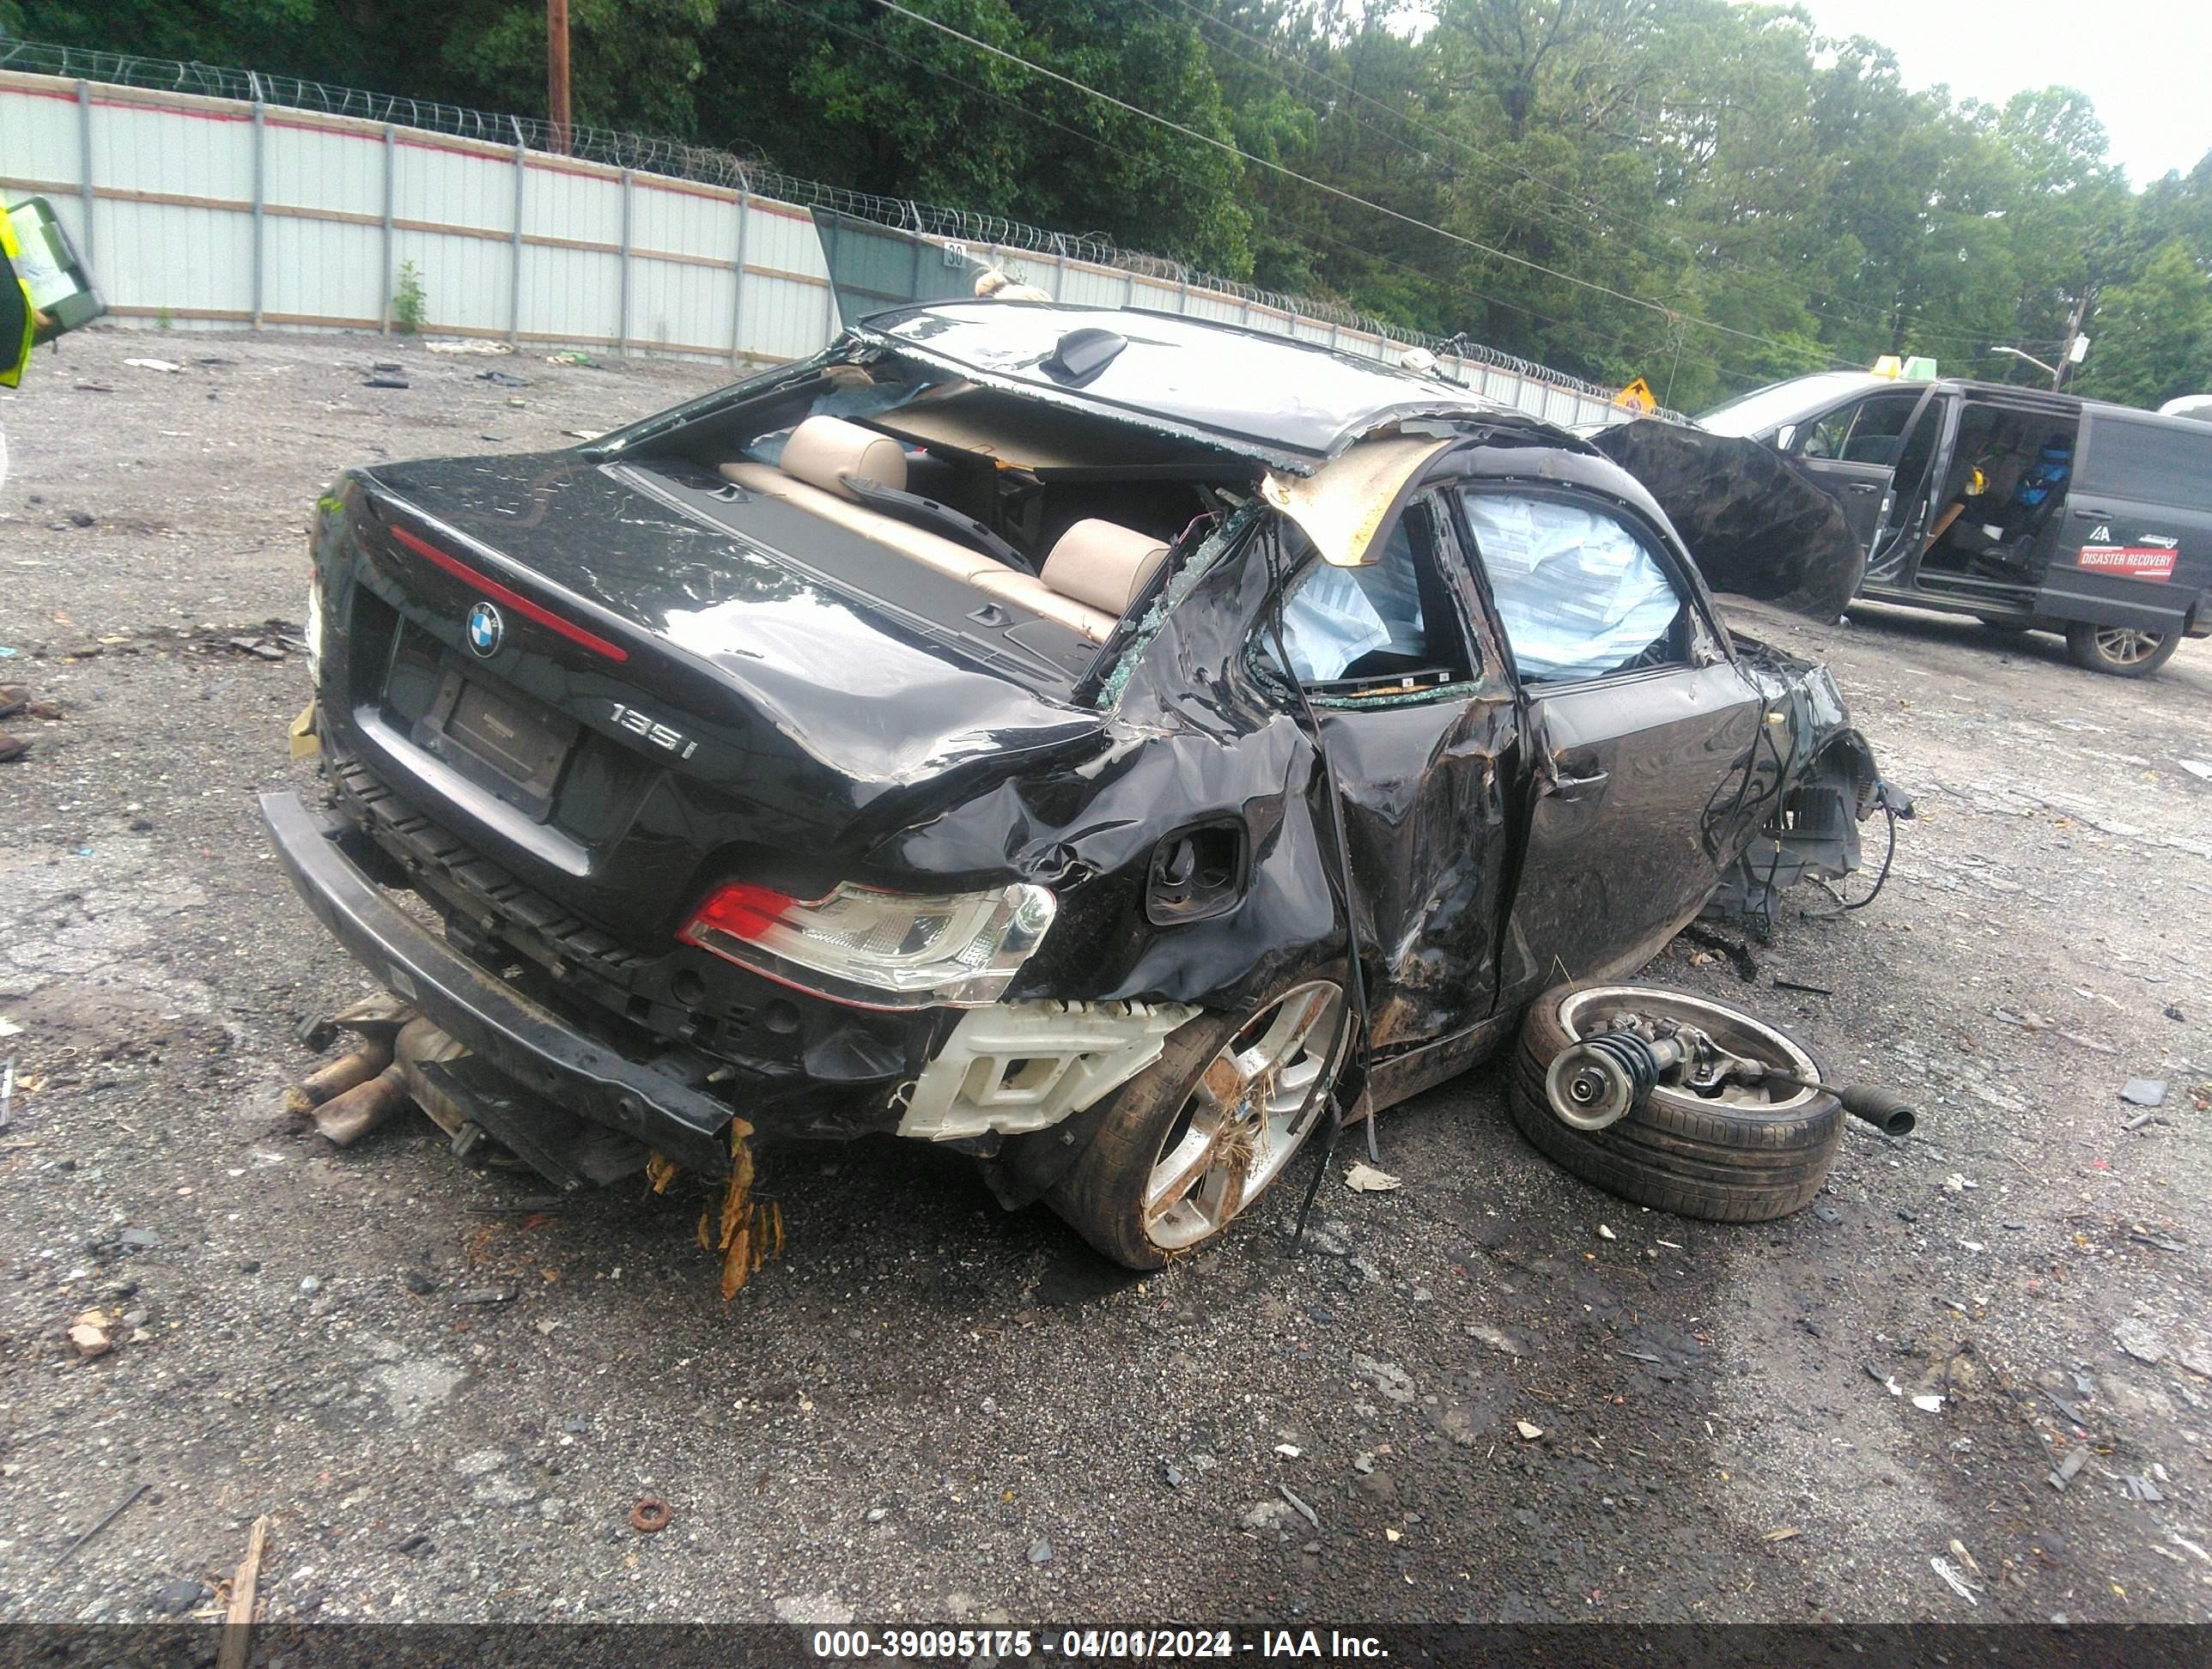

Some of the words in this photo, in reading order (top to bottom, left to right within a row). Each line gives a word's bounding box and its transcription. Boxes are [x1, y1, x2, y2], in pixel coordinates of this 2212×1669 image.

[948, 245, 962, 265] 30
[2081, 553, 2125, 565] DISASTER
[2127, 555, 2172, 567] RECOVERY
[611, 703, 698, 760] 135i
